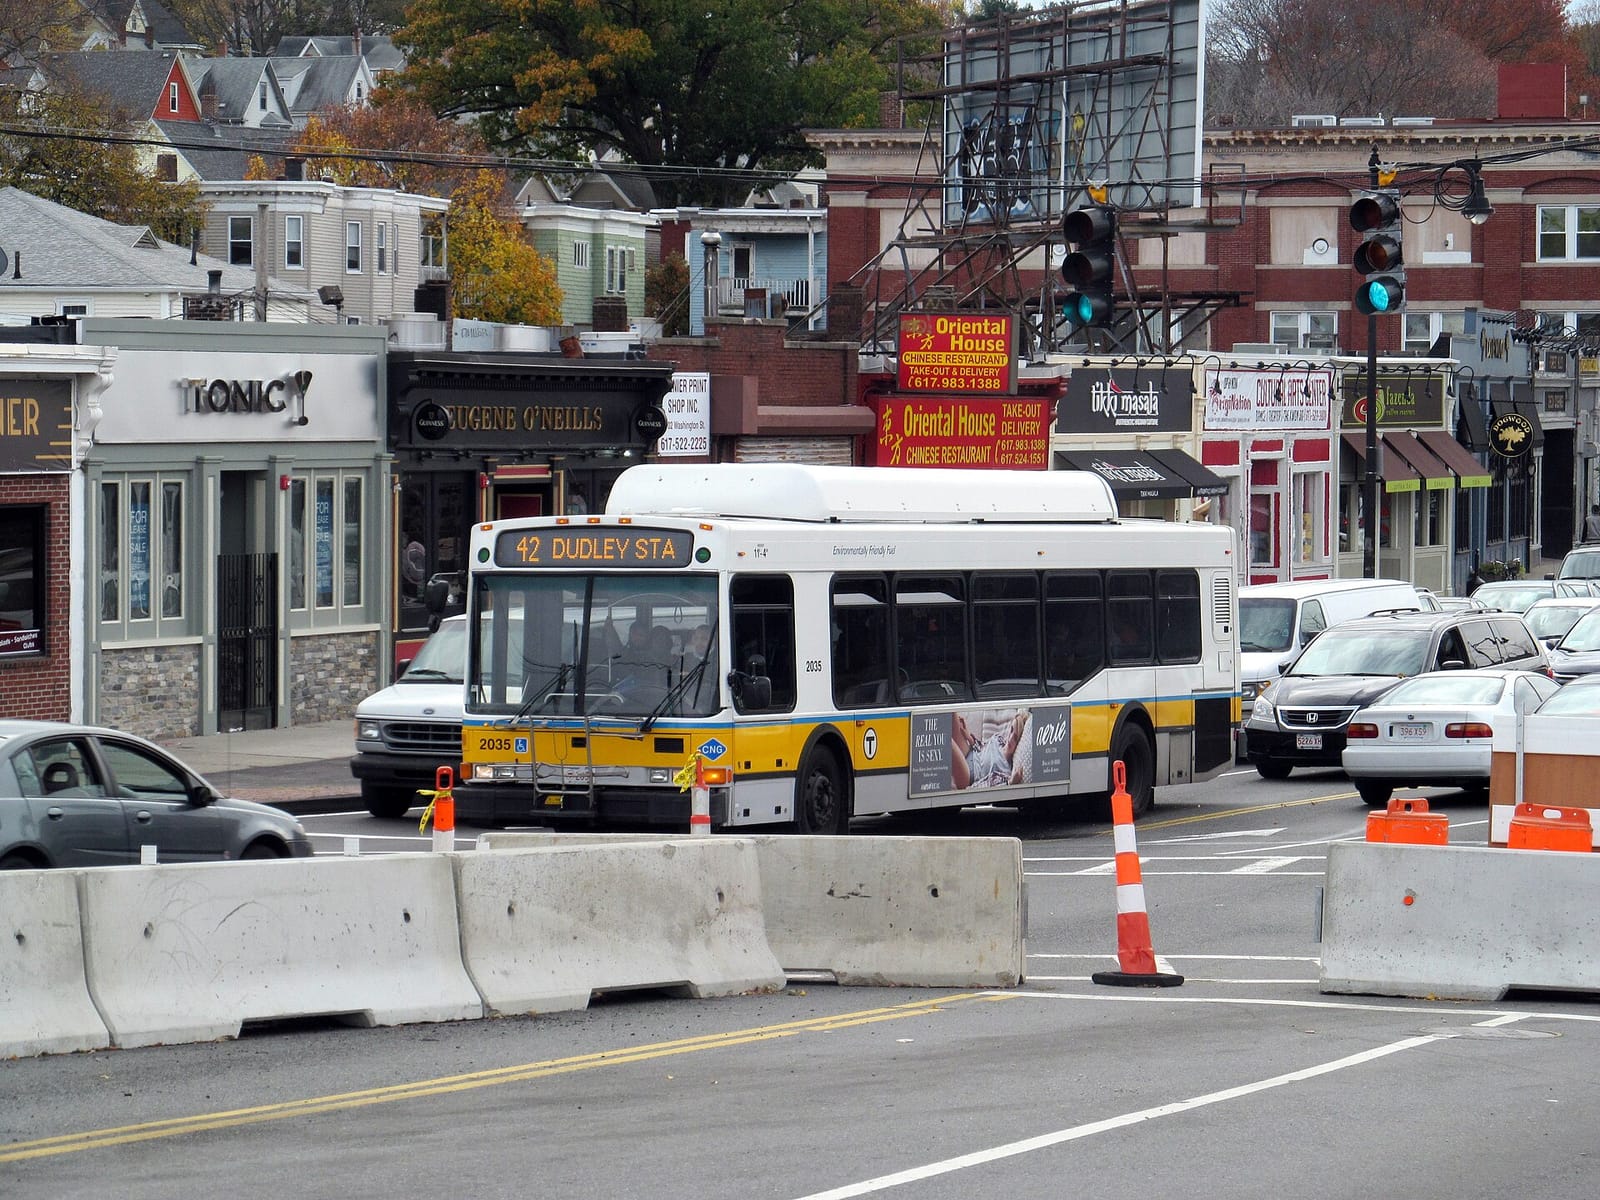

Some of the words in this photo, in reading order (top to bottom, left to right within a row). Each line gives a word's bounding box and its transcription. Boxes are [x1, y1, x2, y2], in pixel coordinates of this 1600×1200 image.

[936, 317, 1006, 335] Oriental
[950, 334, 1005, 352] House
[904, 353, 944, 363] CHINESE
[945, 354, 1006, 364] RESTAURANT
[909, 366, 950, 376] TAKE-OUT
[952, 367, 958, 376] &
[960, 367, 1000, 376] DELIVERY
[689, 379, 707, 393] PRINT
[914, 377, 1001, 389] 617.983.1388
[177, 377, 287, 414] TONIC
[1091, 381, 1118, 418] tikki
[1120, 381, 1160, 416] masala
[1287, 378, 1304, 407] ARTS
[667, 398, 685, 413] SHOP
[686, 398, 700, 414] INC.
[1002, 403, 1042, 418] TAKE-OUT
[0, 397, 40, 436] ER
[419, 418, 445, 427] GUINNESS
[446, 405, 517, 431] EUGENE
[523, 405, 602, 431] O'NEILLS
[638, 419, 662, 428] GUINNESS
[903, 404, 955, 437] Oriental
[958, 405, 996, 437] House
[673, 421, 699, 432] Washington
[1001, 420, 1041, 436] DELIVERY
[1493, 415, 1531, 434] DOGWOOD
[660, 437, 707, 451] 617-522-2225
[1001, 439, 1046, 451] 617.983.1388
[906, 446, 940, 464] CHINESE
[941, 445, 992, 464] RESTAURANT
[1000, 453, 1045, 465] 617.524.1551
[130, 510, 148, 523] FOR
[130, 541, 147, 553] SALE
[515, 536, 541, 562] 42
[552, 537, 630, 560] DUDLEY
[635, 538, 676, 560] STA
[832, 545, 868, 558] Environmentally
[869, 545, 886, 558] Friendly
[806, 660, 822, 673] 2035
[924, 718, 938, 731] THE
[1036, 713, 1067, 747] aerie
[479, 738, 512, 751] 2035
[866, 736, 875, 755] T
[915, 733, 932, 748] REAL
[932, 732, 945, 746] YOU
[701, 745, 724, 754] CNG
